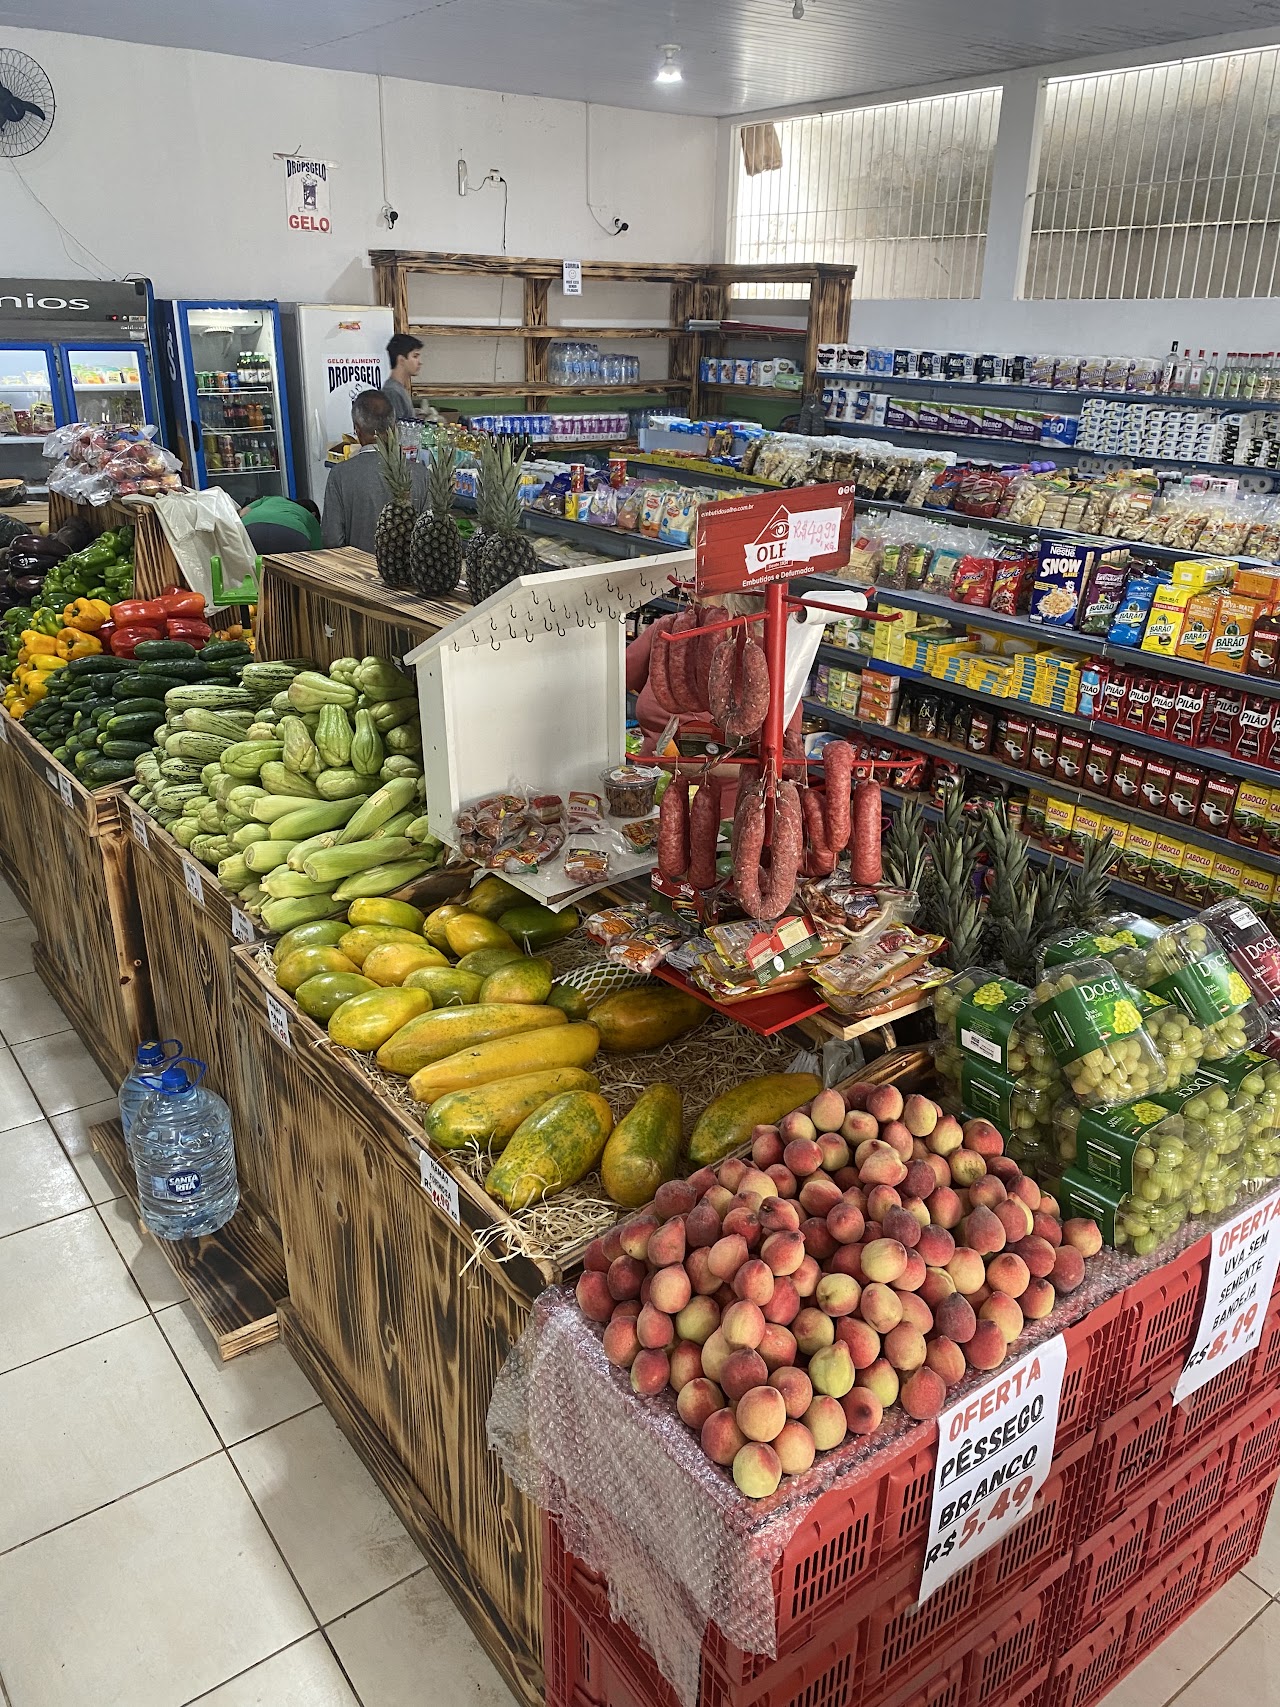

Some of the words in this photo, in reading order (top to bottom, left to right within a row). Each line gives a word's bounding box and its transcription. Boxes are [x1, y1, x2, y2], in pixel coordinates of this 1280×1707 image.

[289, 215, 330, 232] GELO
[328, 365, 382, 393] DROPSGELO
[1040, 558, 1083, 578] SNOW
[742, 574, 774, 588] Embutidos
[781, 566, 815, 579] Defumados
[1216, 636, 1245, 648] BARÃO
[1176, 695, 1201, 711] PILÃO
[1216, 699, 1240, 714] PILÃO
[1241, 712, 1269, 728] PILÃO
[1091, 743, 1112, 757] Damasco
[1120, 753, 1143, 767] Damasco
[1147, 762, 1171, 776] Damasco
[1175, 771, 1200, 786] Damasco
[1208, 781, 1235, 796] Damasco
[1240, 792, 1268, 806] CABOCLO
[1048, 806, 1069, 819] CABOCLO
[1076, 816, 1098, 828] CABOCLO
[1129, 834, 1152, 848] CABOCLO
[1156, 843, 1181, 856] CABOCLO
[1185, 852, 1211, 866] CABOCLO
[1215, 862, 1240, 877] CABOCLO
[1243, 877, 1270, 892] CABOCLO
[1057, 930, 1092, 948] DOCE
[1245, 935, 1279, 960] DOCE
[1197, 953, 1230, 978] DOCE
[1079, 978, 1121, 1001] DOCE
[1175, 1077, 1213, 1099] DOCE
[168, 1173, 199, 1186] SANTA
[175, 1181, 196, 1192] RITA
[1219, 1199, 1280, 1258] OFERTA
[1224, 1248, 1244, 1275] UVA
[1248, 1230, 1269, 1254] SEM
[1219, 1256, 1264, 1304] SEMENTE
[1212, 1282, 1257, 1330] BANDEJA
[1184, 1341, 1210, 1374] R$
[1206, 1302, 1259, 1361] 8,99
[949, 1356, 1041, 1442] OFERTA
[940, 1394, 1044, 1488] PÊSSEGO
[938, 1444, 1038, 1532] BRANCO
[924, 1529, 957, 1572] R$
[958, 1475, 1034, 1549] 5,49
